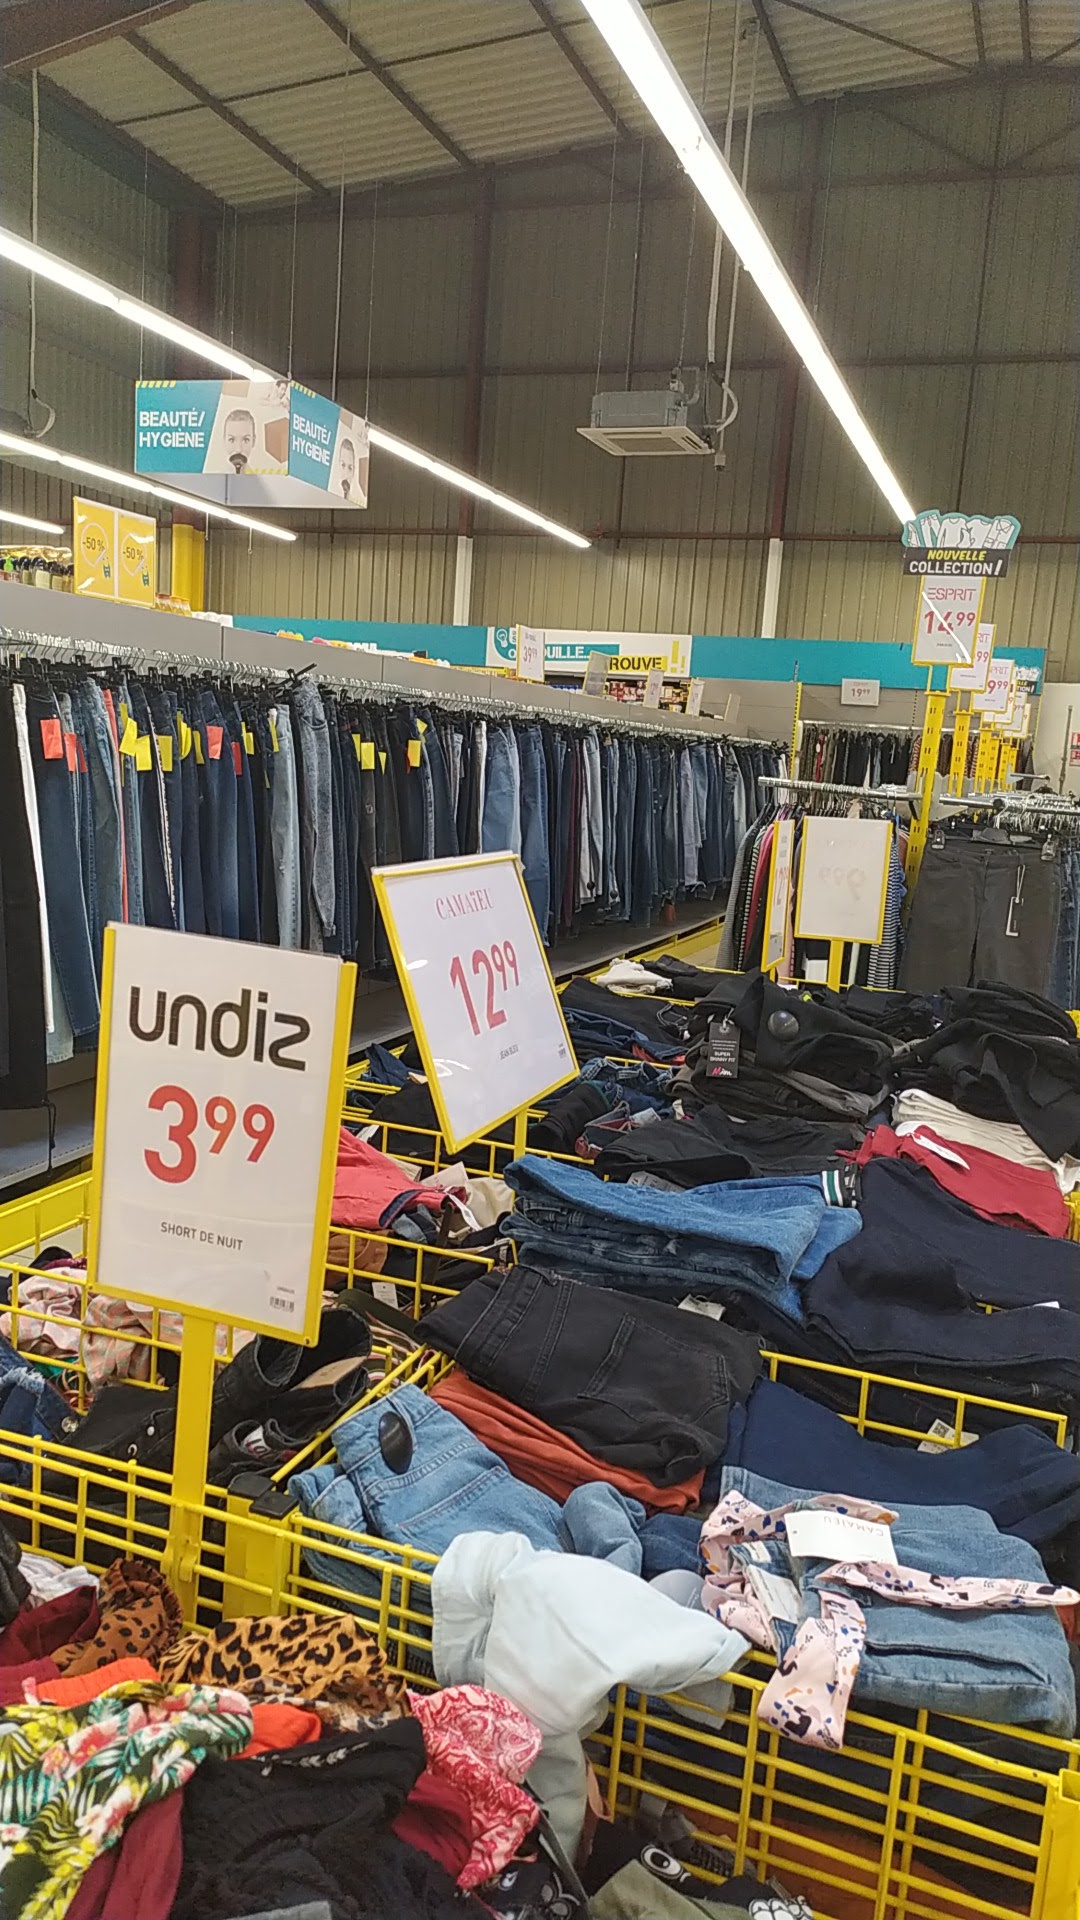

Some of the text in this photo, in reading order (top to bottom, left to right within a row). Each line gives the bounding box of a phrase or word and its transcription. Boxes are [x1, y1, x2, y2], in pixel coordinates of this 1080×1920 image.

[139, 407, 206, 427] BEAUTÉ/
[139, 427, 205, 448] HYGIÈNE
[293, 413, 332, 446] BEAUTÉ/
[292, 434, 331, 467] HYGIÈNE
[927, 550, 987, 561] NOUVELLE
[927, 587, 977, 601] ESPRIT
[977, 632, 991, 643] RIT
[608, 656, 663, 671] ROUVE
[976, 650, 990, 663] 99
[990, 666, 1009, 675] PRIT
[450, 939, 520, 1037] 1299
[129, 985, 311, 1072] undiz
[143, 1084, 276, 1184] 399
[160, 1221, 244, 1251] SHORT DE NUIT
